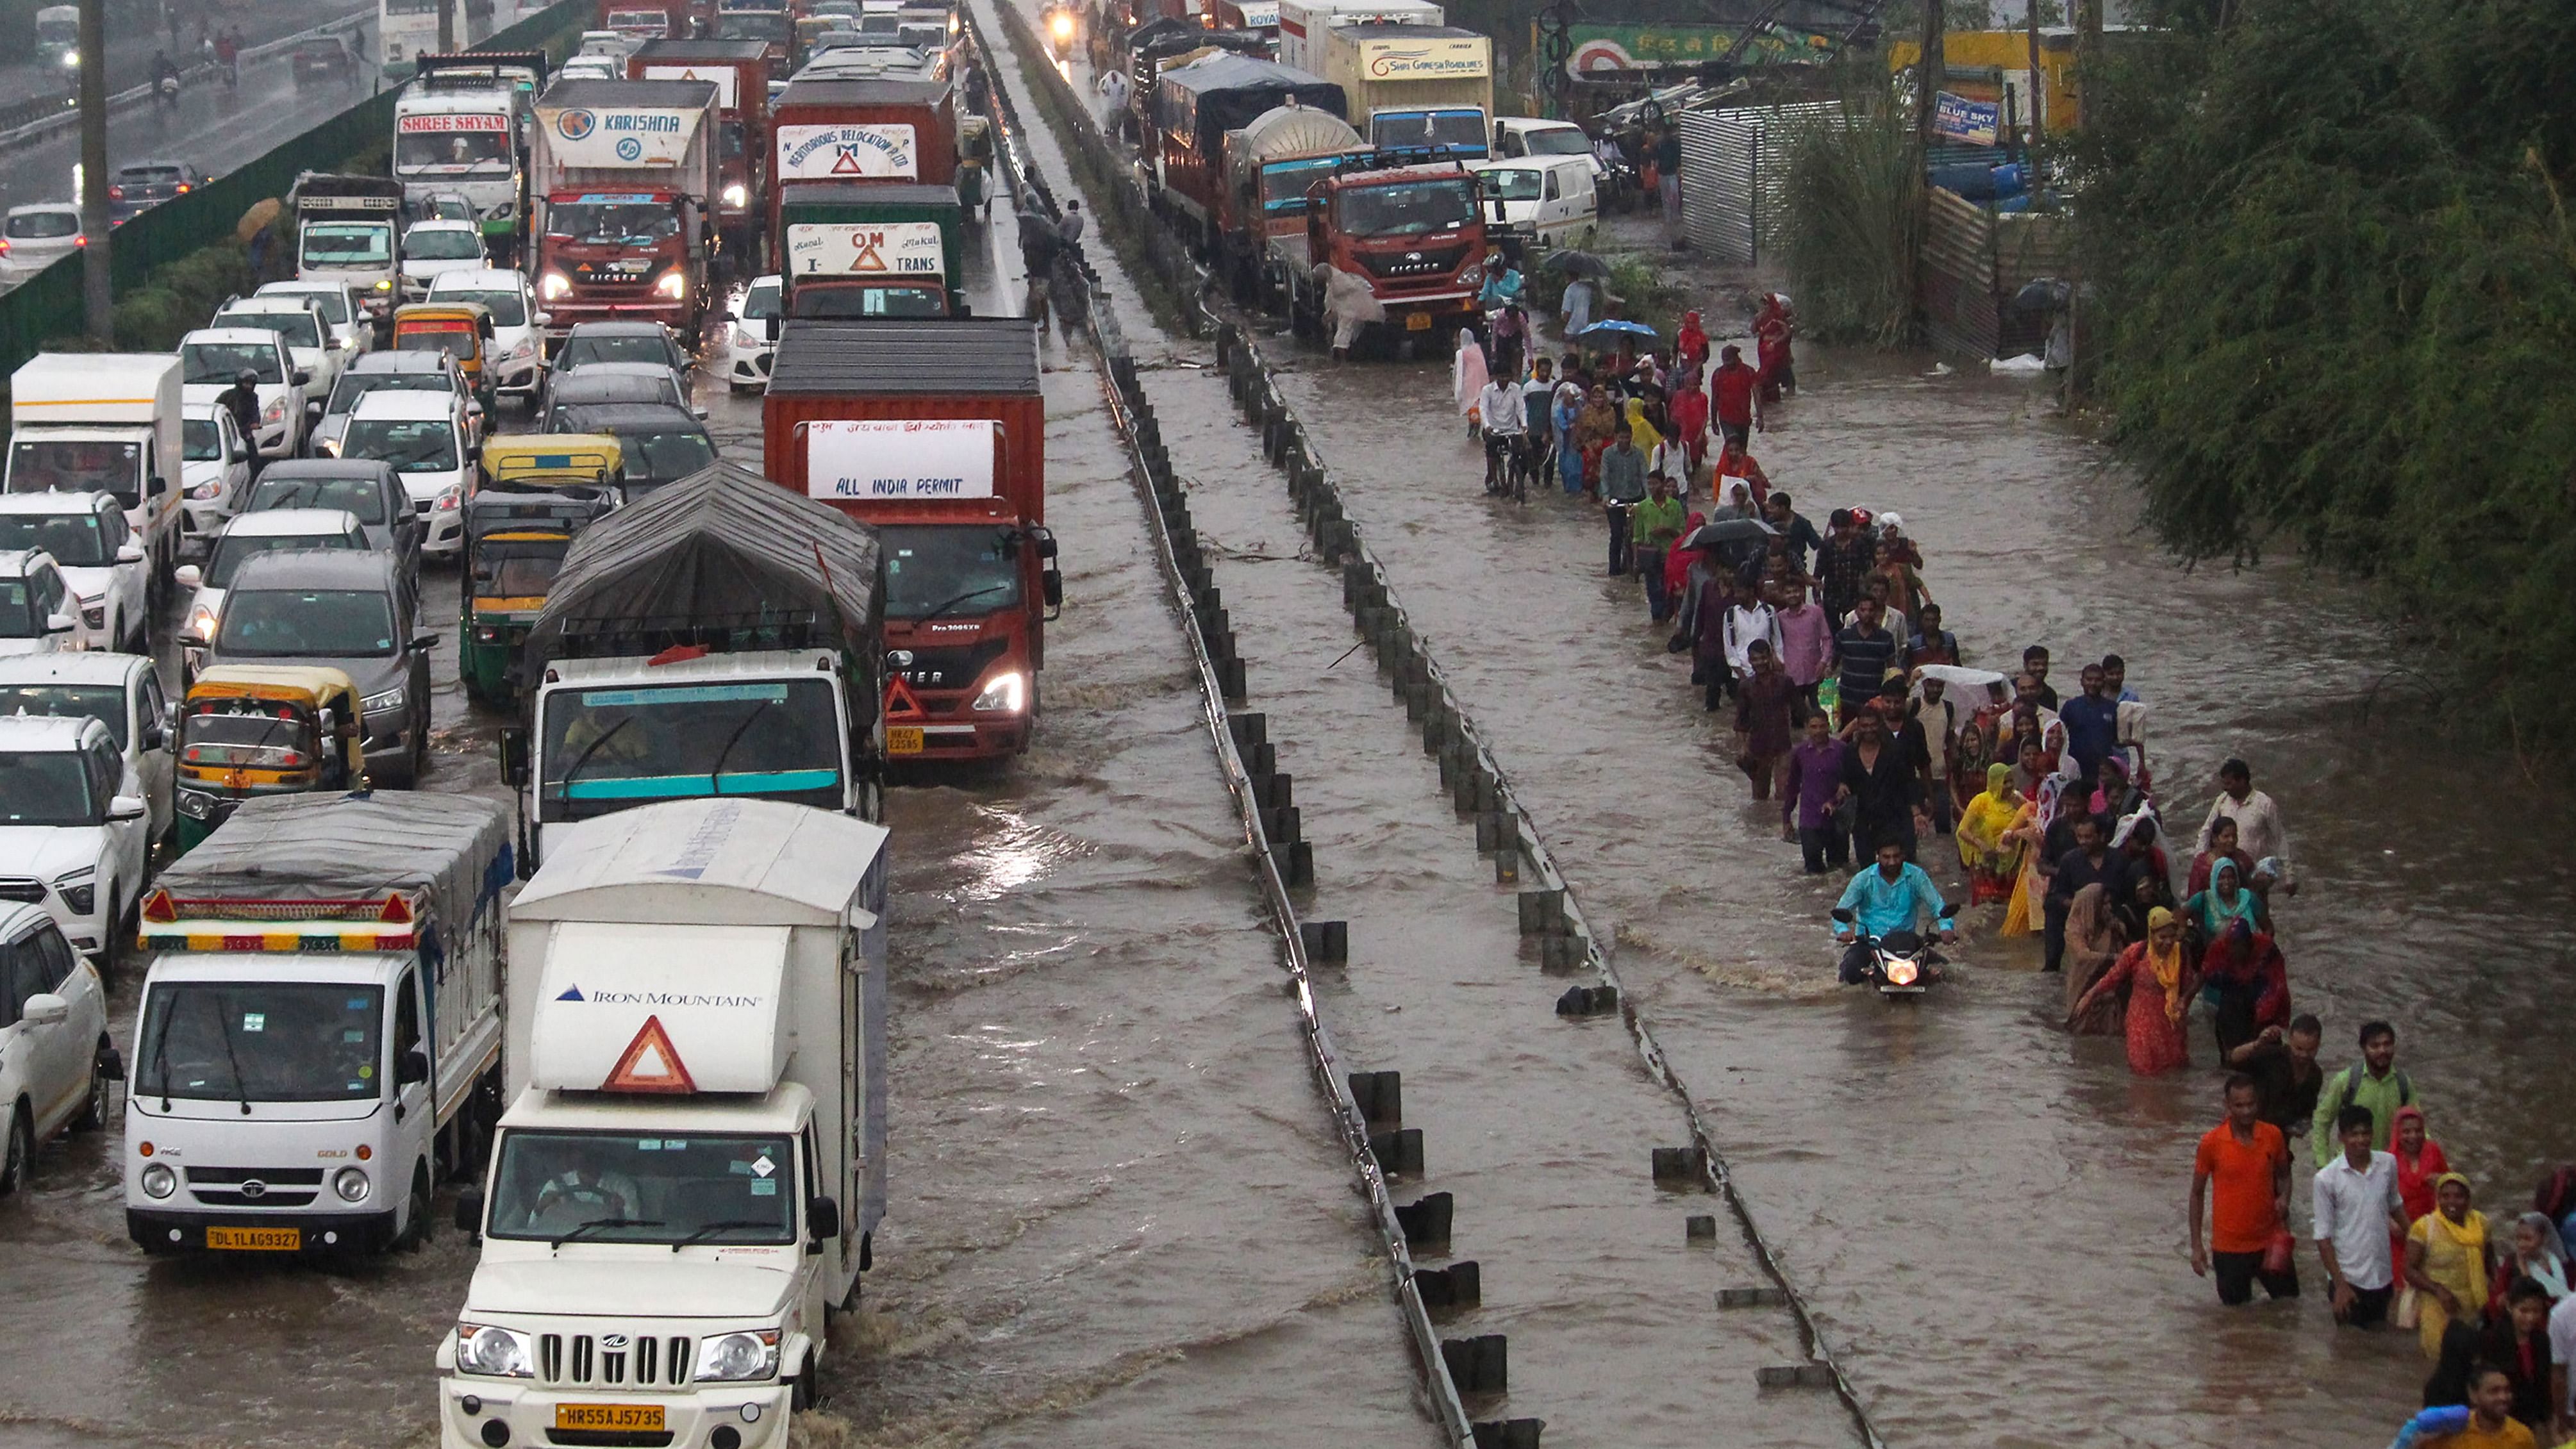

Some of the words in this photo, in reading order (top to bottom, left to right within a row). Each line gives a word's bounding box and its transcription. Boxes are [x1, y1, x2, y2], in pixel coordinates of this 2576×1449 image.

[1939, 105, 1967, 118] BLUE
[1971, 112, 1994, 122] SKY
[403, 117, 451, 131] SHREE
[456, 115, 504, 129] SHYAM
[604, 115, 680, 132] KARISHNA
[788, 131, 838, 169] MERITORIOUS
[842, 129, 892, 153] RELOCATION
[852, 232, 884, 248] OM
[897, 258, 935, 271] TRANS
[1390, 263, 1438, 272] EICHER
[836, 477, 860, 495] ALL
[872, 479, 908, 495] INDIA
[917, 478, 963, 495] PERMIT
[593, 991, 642, 1004] IRON
[646, 993, 758, 1007] MOUNTAIN
[317, 1150, 348, 1158] GOLD
[215, 1232, 298, 1246] DL1LAG9327
[567, 1409, 661, 1426] HR55AJ5735
